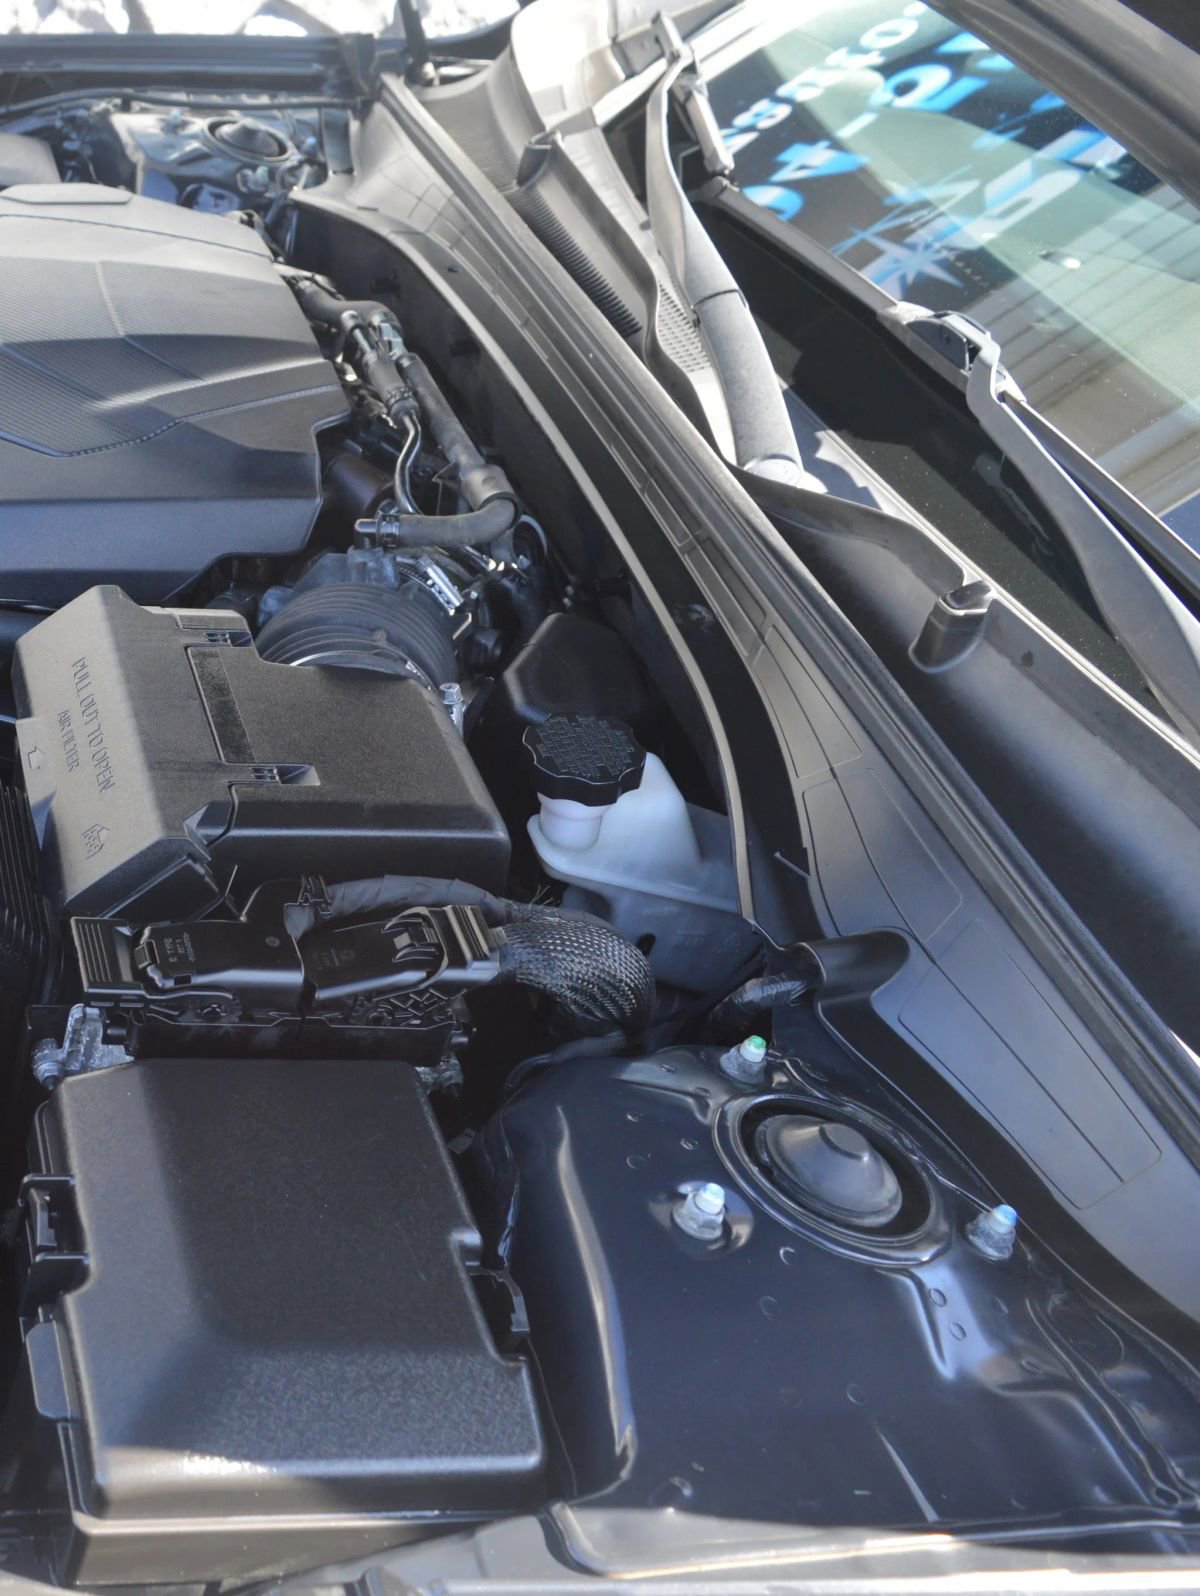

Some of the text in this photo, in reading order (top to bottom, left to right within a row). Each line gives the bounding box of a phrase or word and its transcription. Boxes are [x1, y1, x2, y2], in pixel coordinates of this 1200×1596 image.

[57, 709, 80, 773] AIR FILTER
[71, 656, 116, 794] PULL OUT TO OPEN
